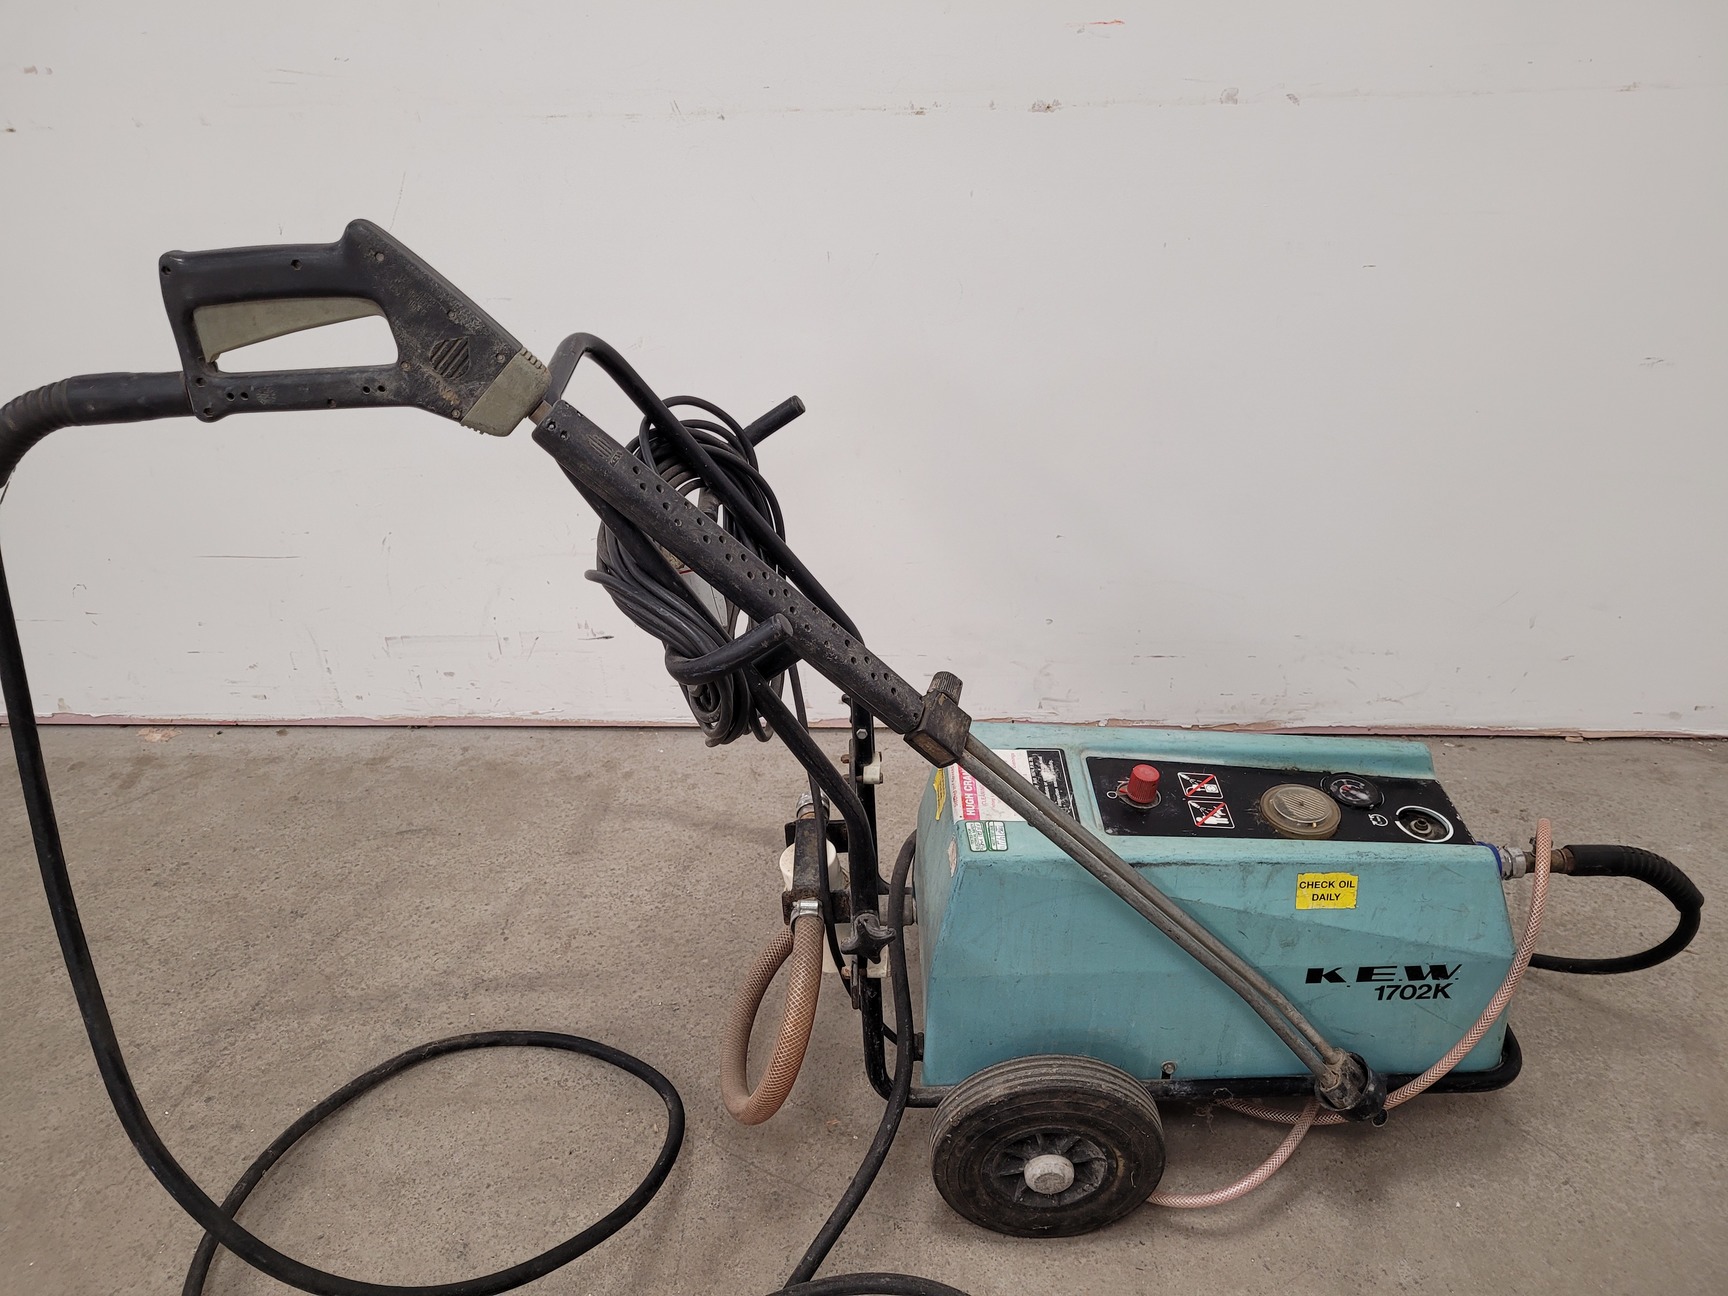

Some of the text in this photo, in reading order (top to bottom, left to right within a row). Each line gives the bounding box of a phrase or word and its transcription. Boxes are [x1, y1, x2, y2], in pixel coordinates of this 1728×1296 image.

[964, 793, 976, 816] HUGH
[1299, 880, 1356, 889] CHECK OIL
[1311, 893, 1341, 901] DAILY
[1374, 982, 1454, 1001] 1702K
